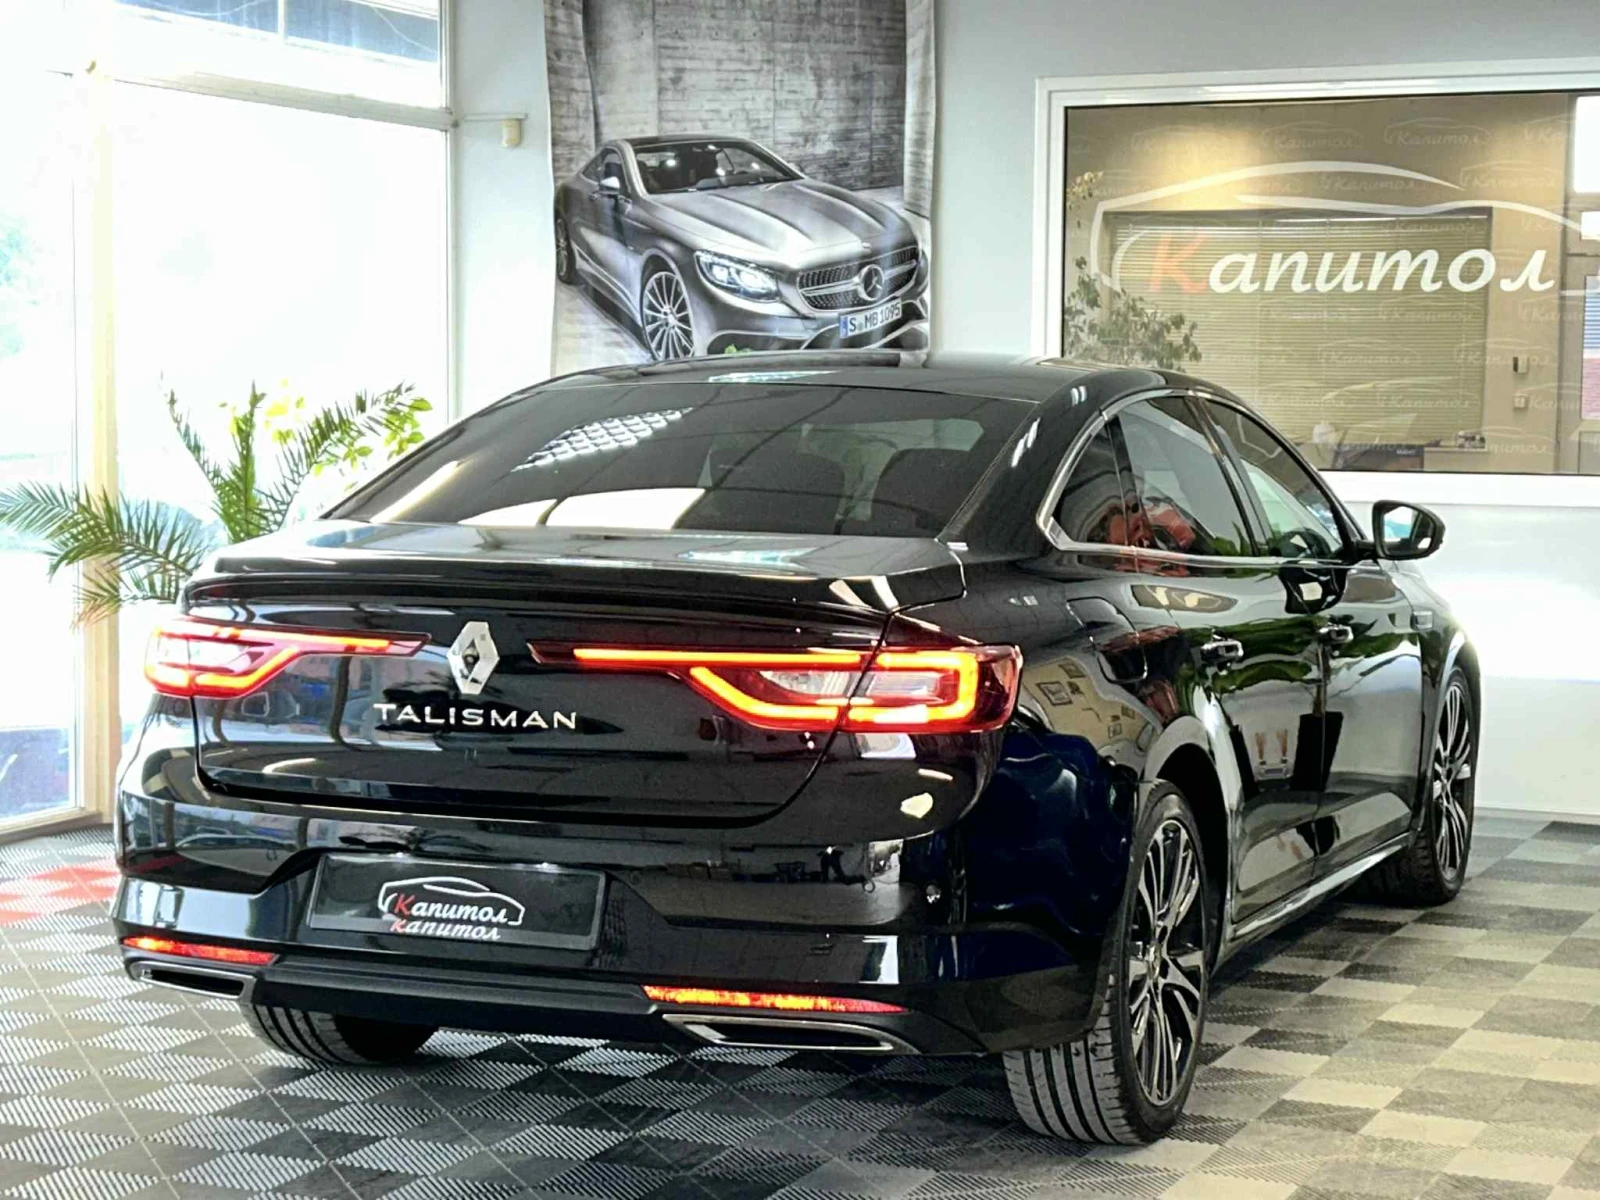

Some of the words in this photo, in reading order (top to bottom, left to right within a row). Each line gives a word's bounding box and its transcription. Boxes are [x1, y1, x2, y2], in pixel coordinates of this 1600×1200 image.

[1149, 230, 1555, 293] Капитол
[849, 317, 857, 333] S
[864, 311, 879, 329] MB
[373, 703, 577, 729] TALISMAN
[393, 893, 508, 924] Капитол
